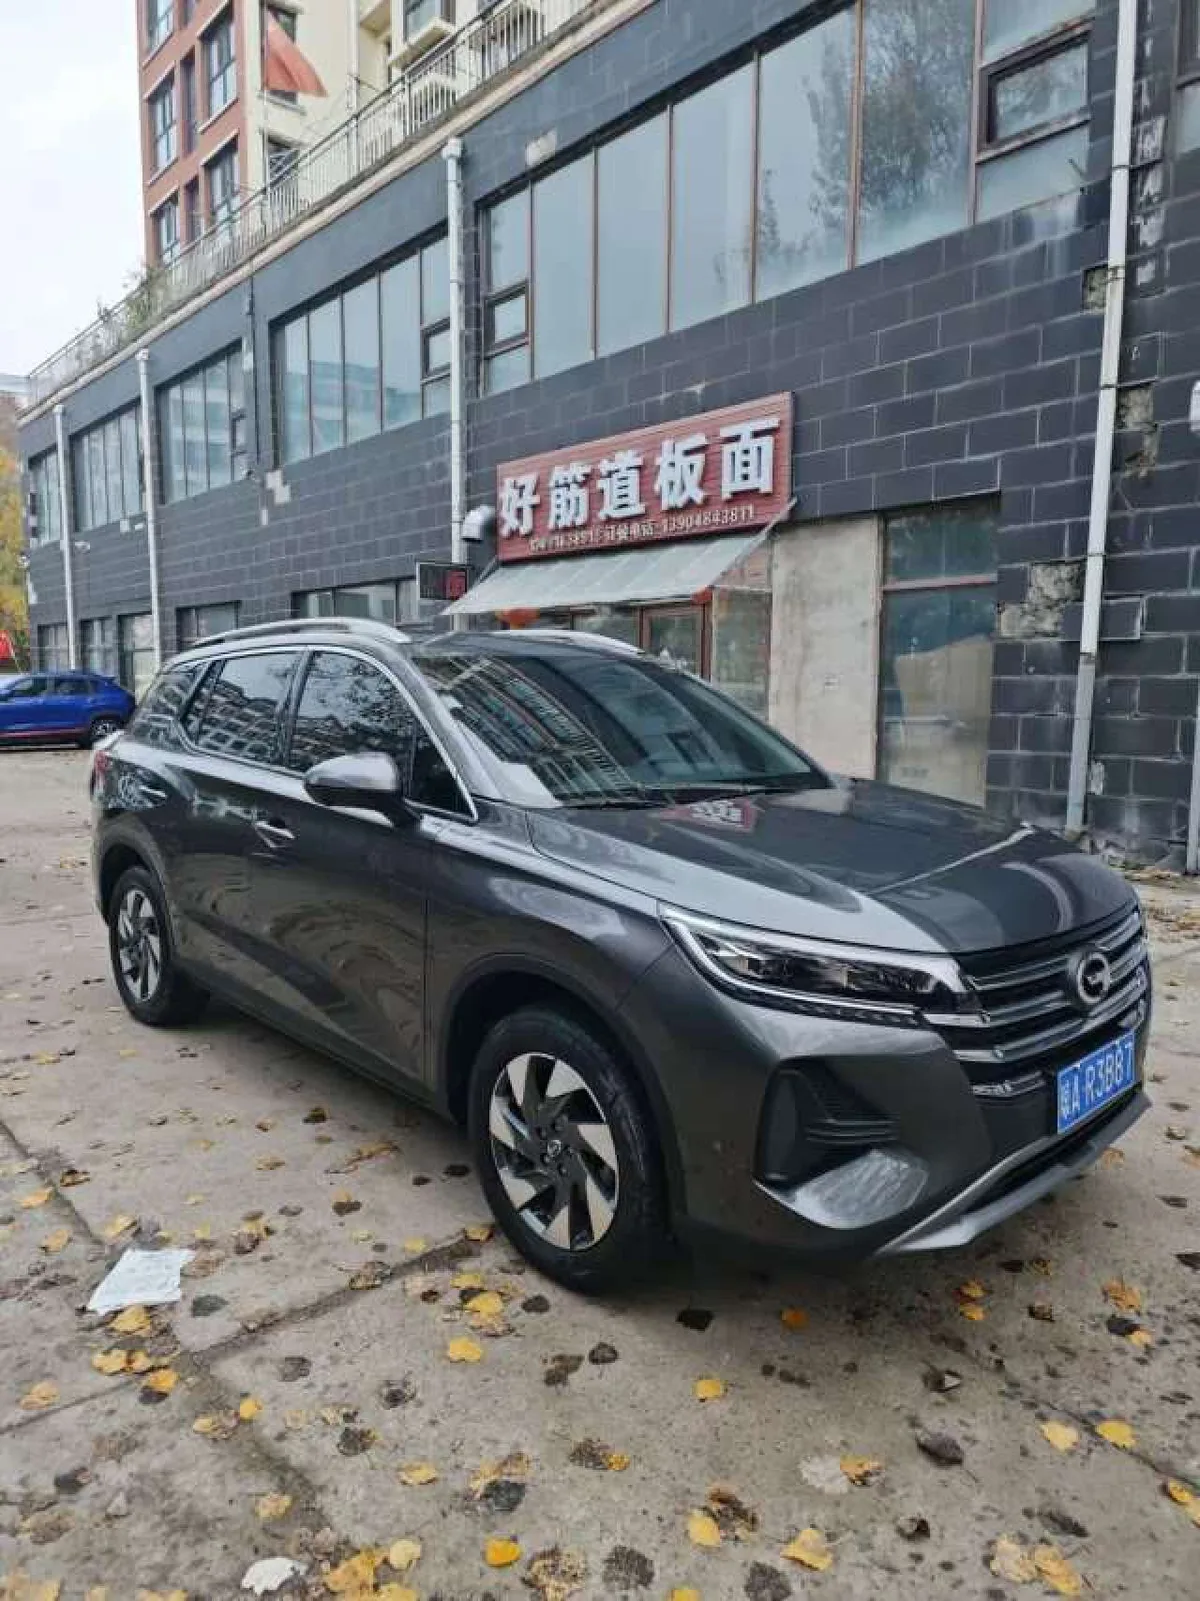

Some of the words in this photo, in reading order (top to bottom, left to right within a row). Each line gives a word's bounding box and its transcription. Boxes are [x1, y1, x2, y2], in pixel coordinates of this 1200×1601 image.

[500, 418, 780, 538] 好筋道板面
